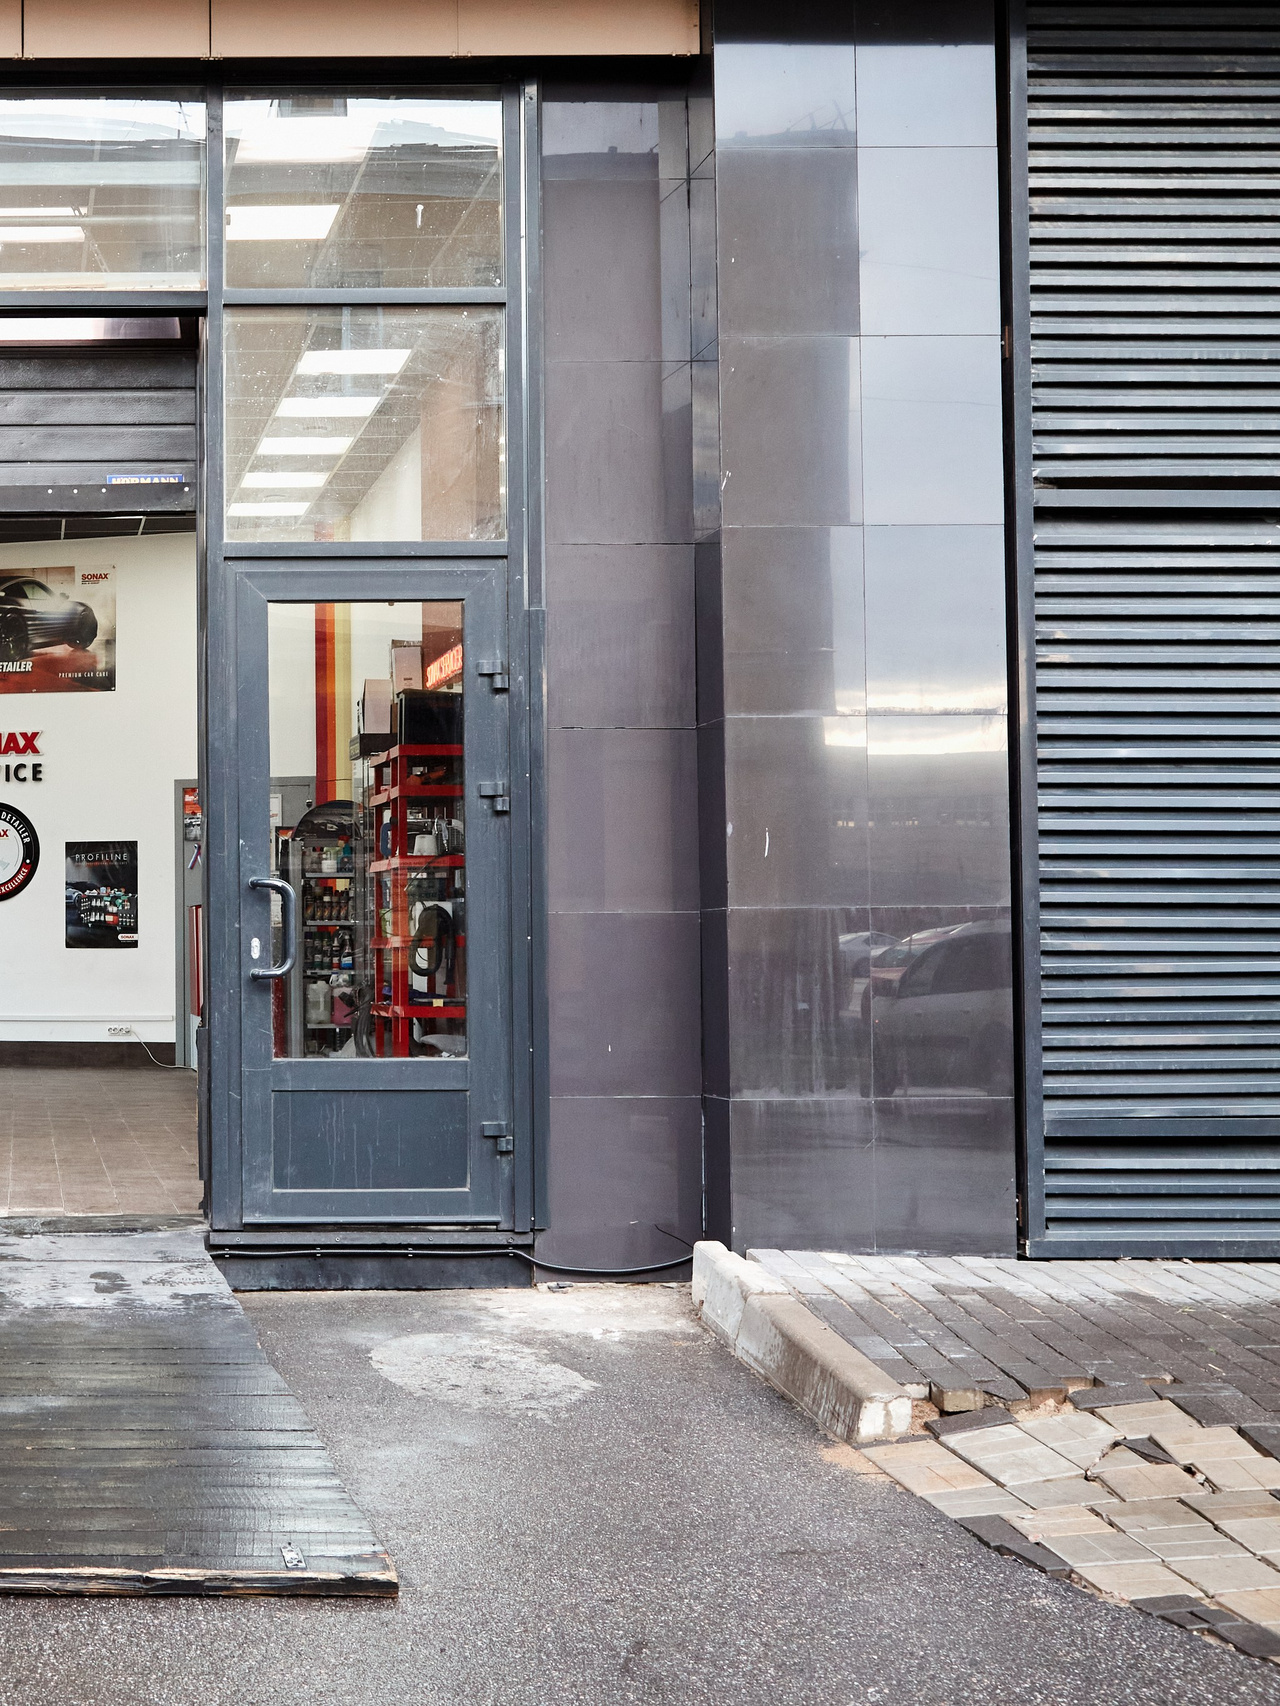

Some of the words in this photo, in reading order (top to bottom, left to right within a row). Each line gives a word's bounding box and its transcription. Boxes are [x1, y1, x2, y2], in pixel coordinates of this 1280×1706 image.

[81, 573, 109, 581] SONAX
[0, 811, 31, 844] DETAILER
[75, 853, 128, 862] PROFILINE
